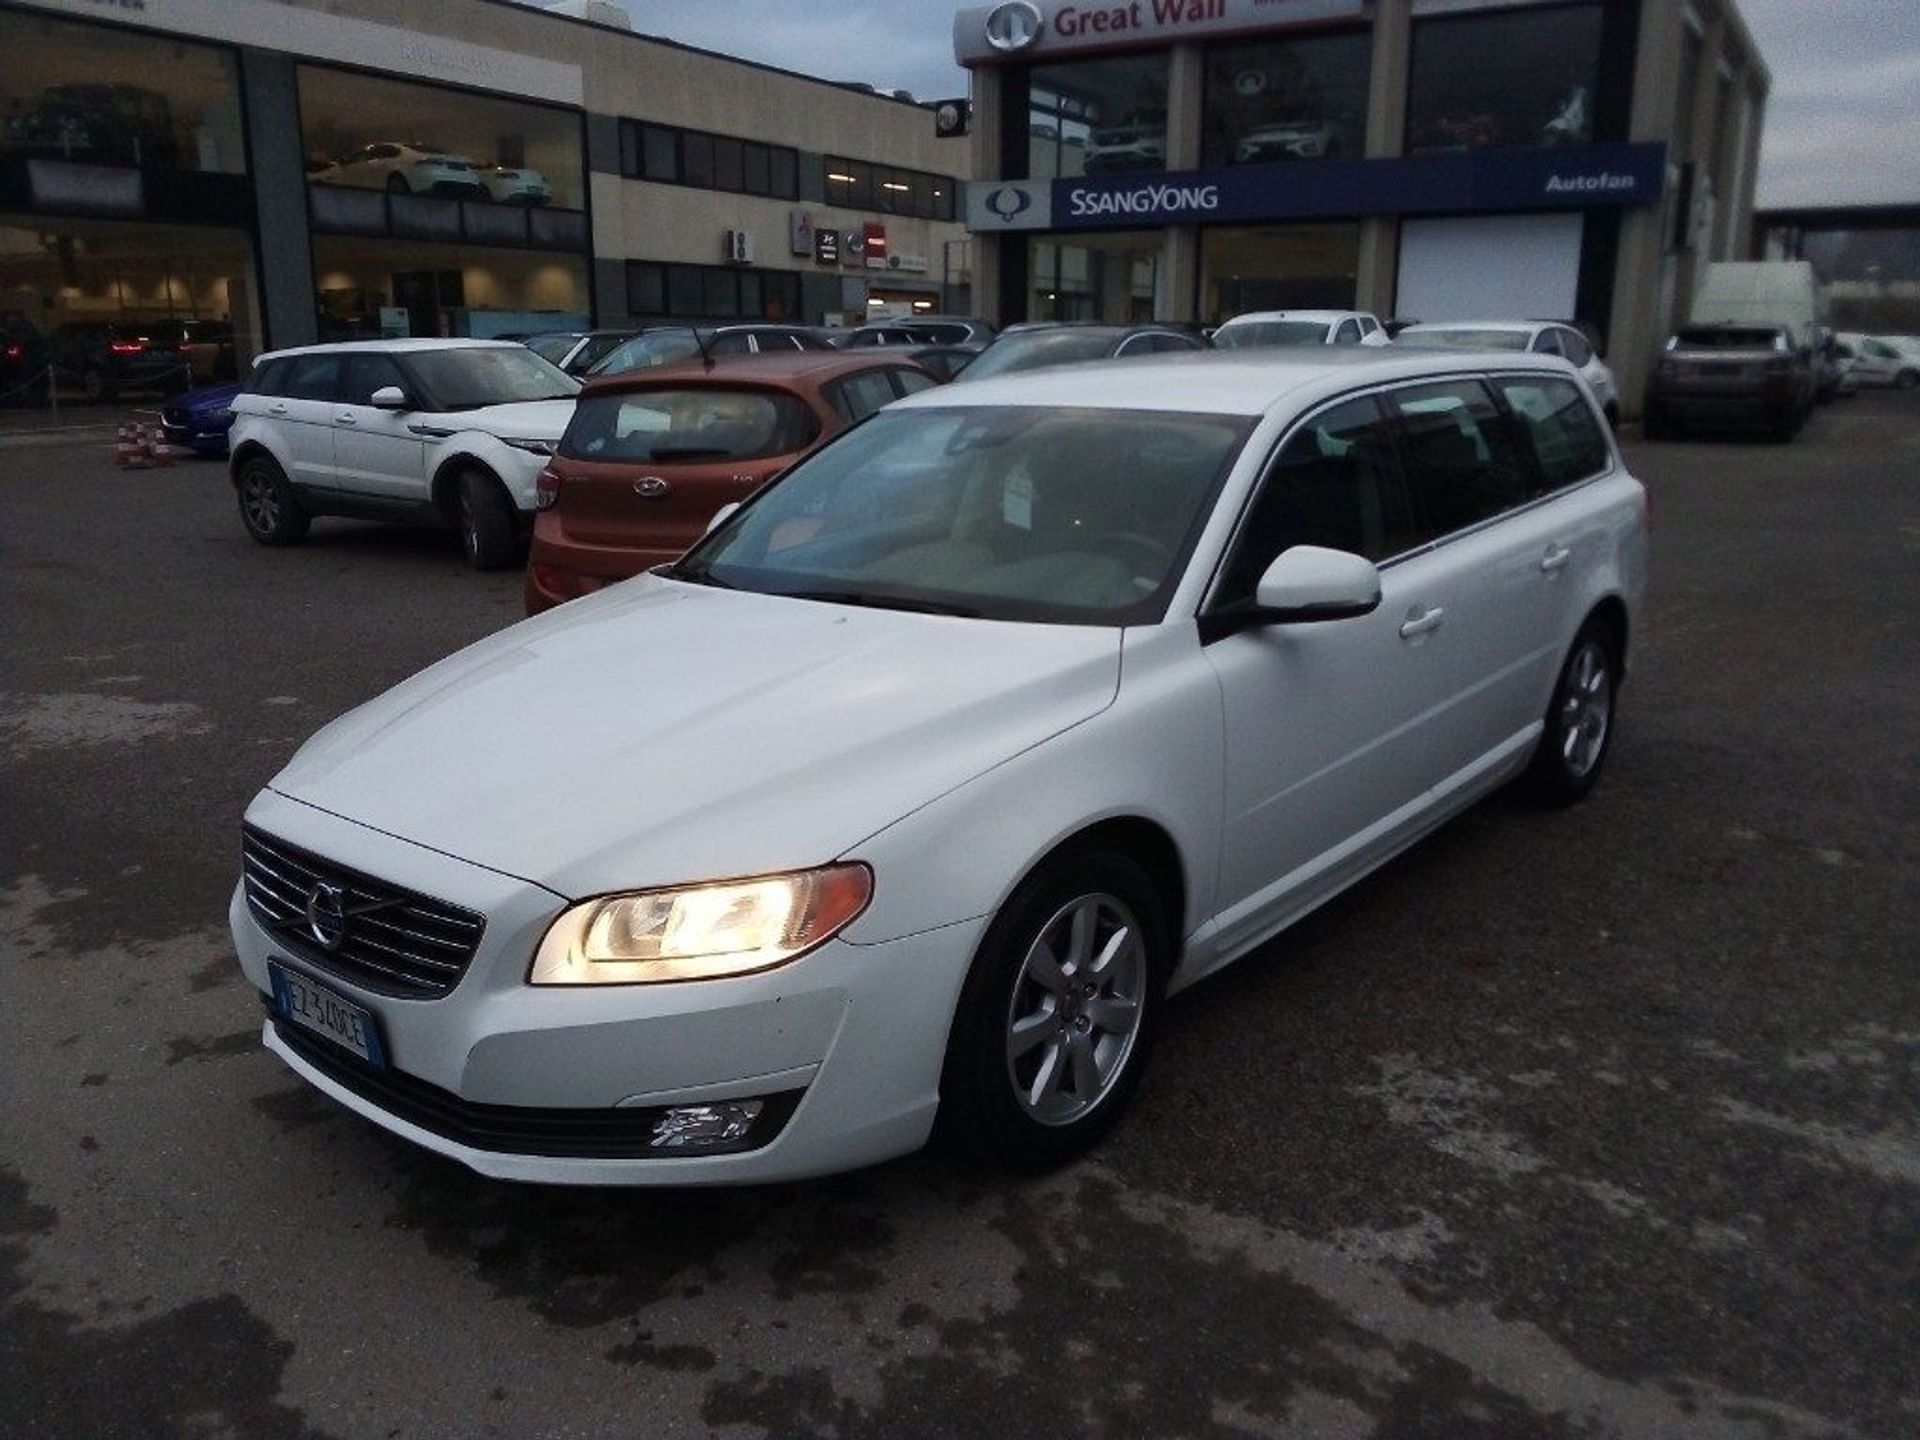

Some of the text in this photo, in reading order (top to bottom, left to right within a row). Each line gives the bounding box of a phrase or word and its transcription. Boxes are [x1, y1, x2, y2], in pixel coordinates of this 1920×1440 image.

[1054, 0, 1226, 37] Great Wall
[1545, 172, 1635, 192] Autofan
